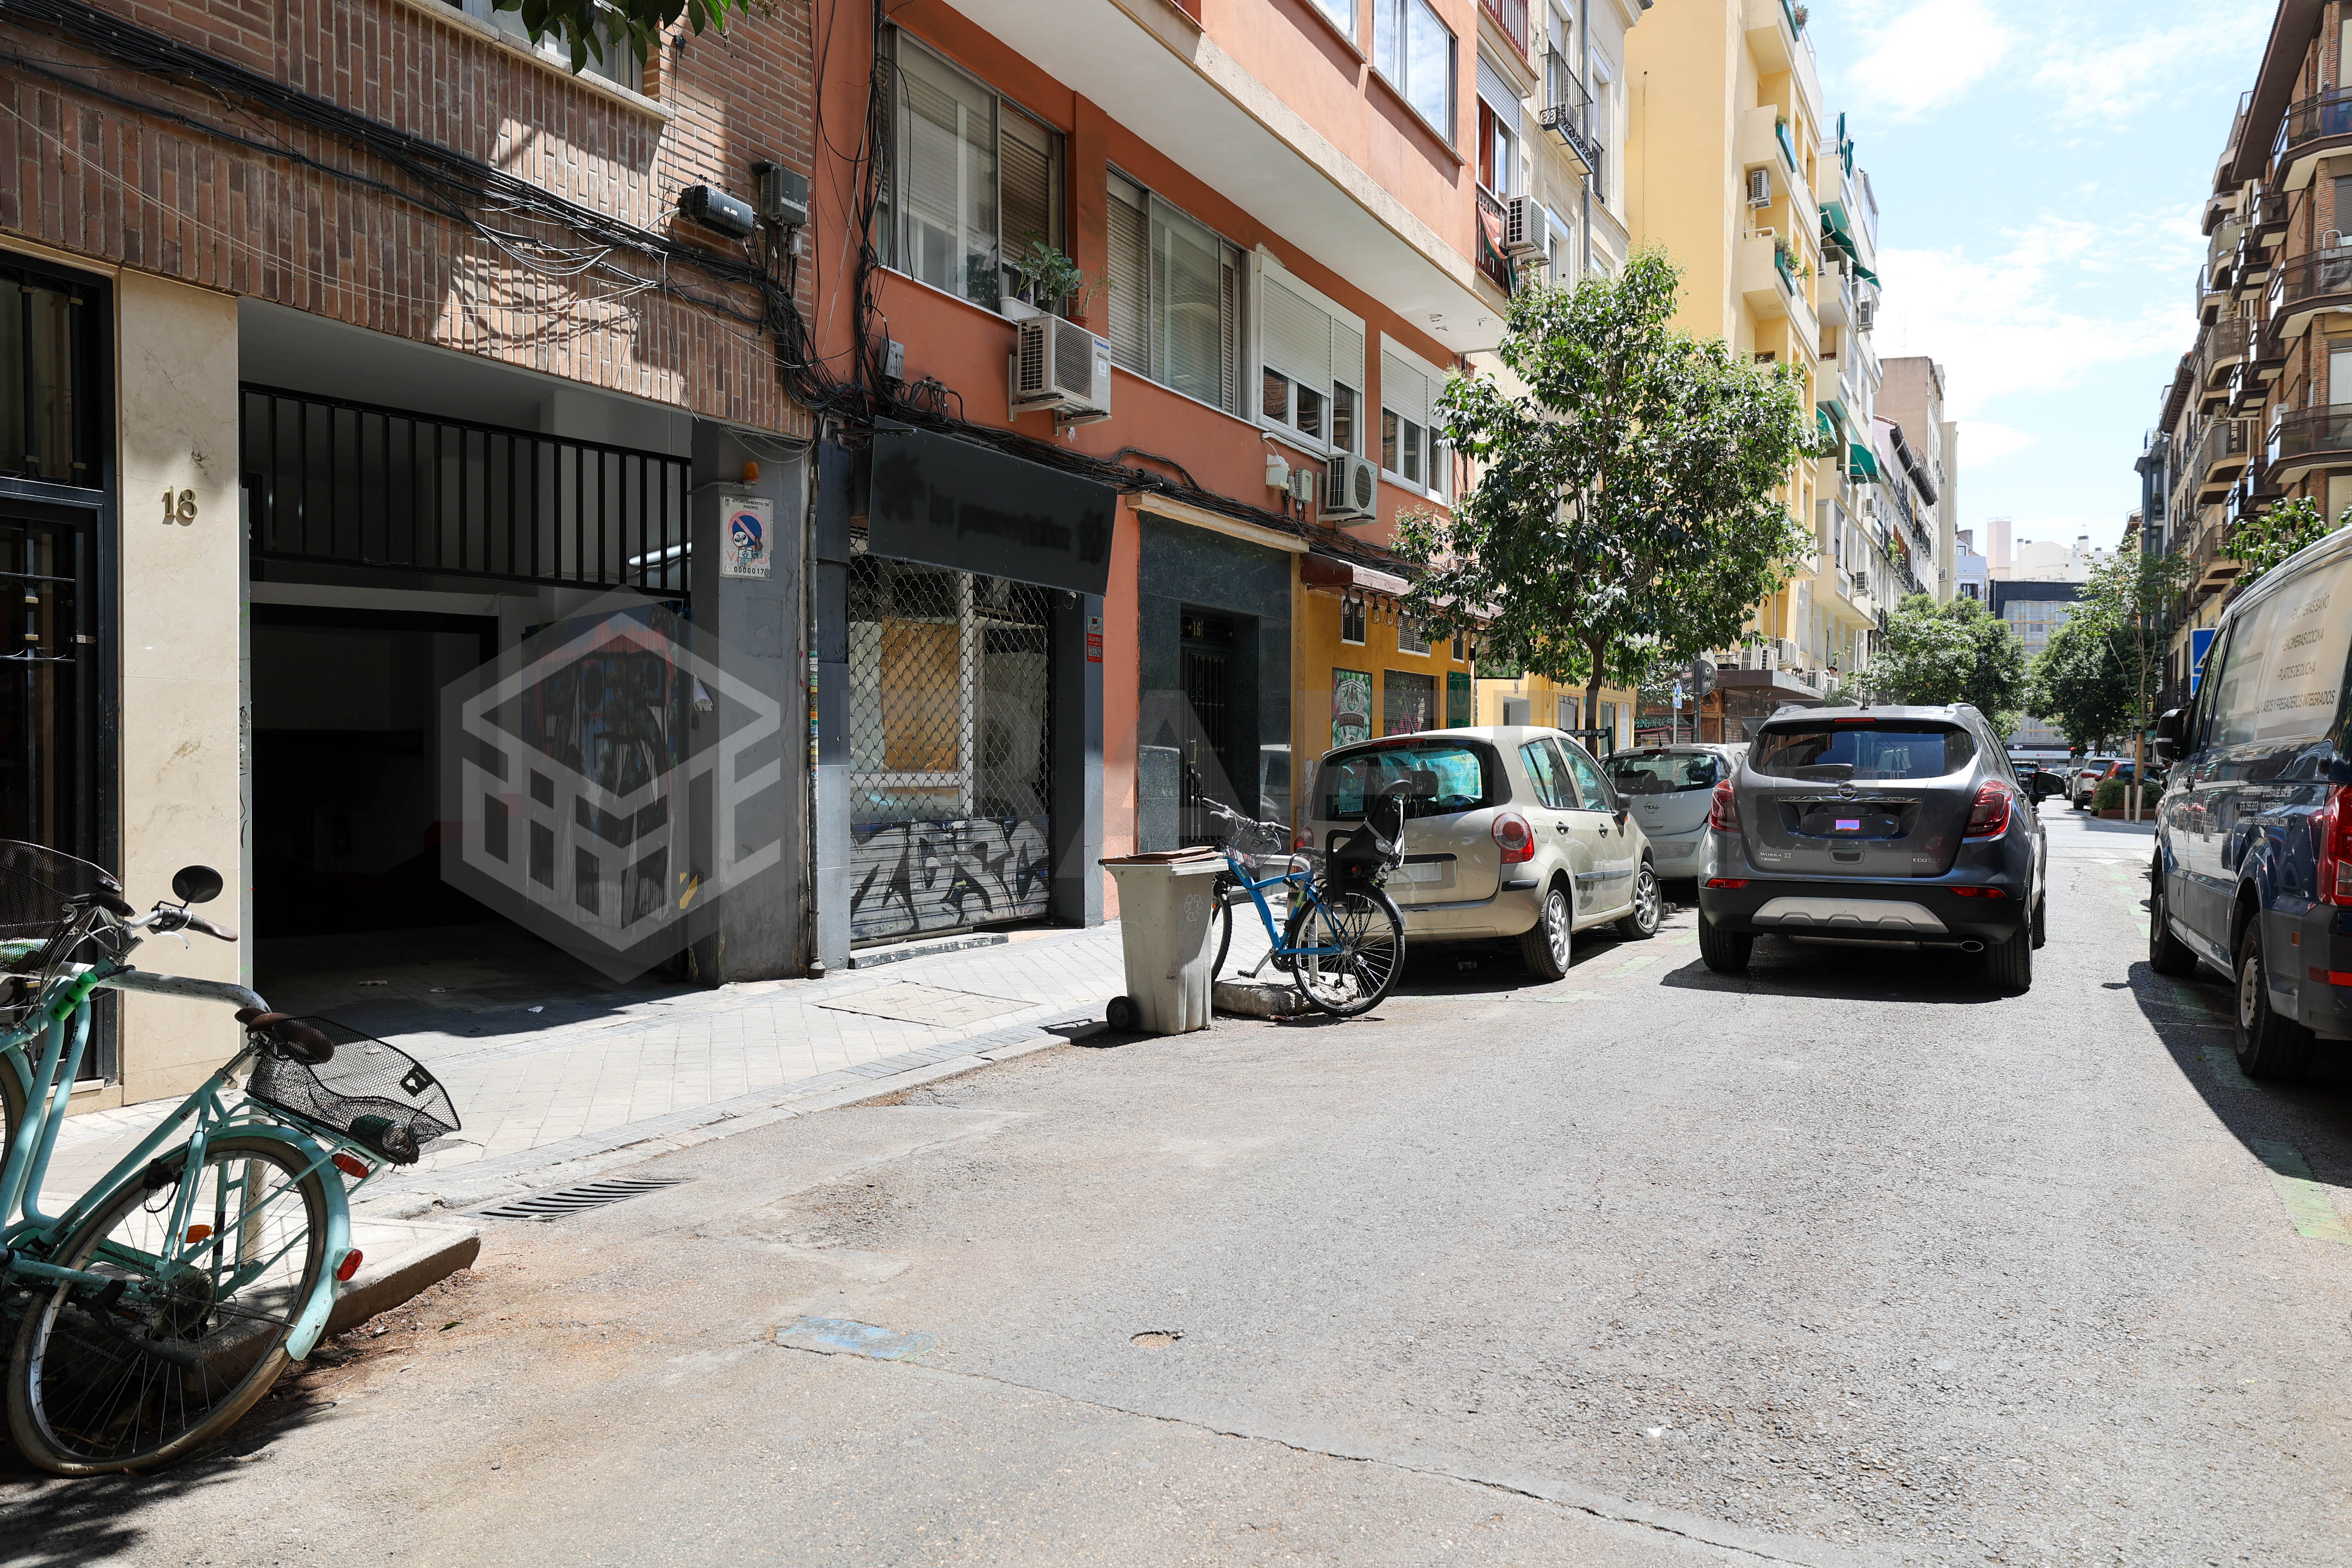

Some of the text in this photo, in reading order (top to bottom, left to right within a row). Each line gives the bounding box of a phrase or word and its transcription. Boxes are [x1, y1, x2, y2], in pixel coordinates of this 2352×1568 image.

[1094, 340, 1110, 350] Panasonic
[163, 485, 198, 519] 18
[726, 550, 768, 565] VO
[1193, 621, 1201, 636] 16
[2306, 627, 2324, 645] COCINA
[2293, 664, 2300, 678] DE
[2300, 660, 2316, 677] DUCHA
[2303, 689, 2336, 707] INTEGRADOS
[1340, 714, 1364, 726] BEERHOUSE
